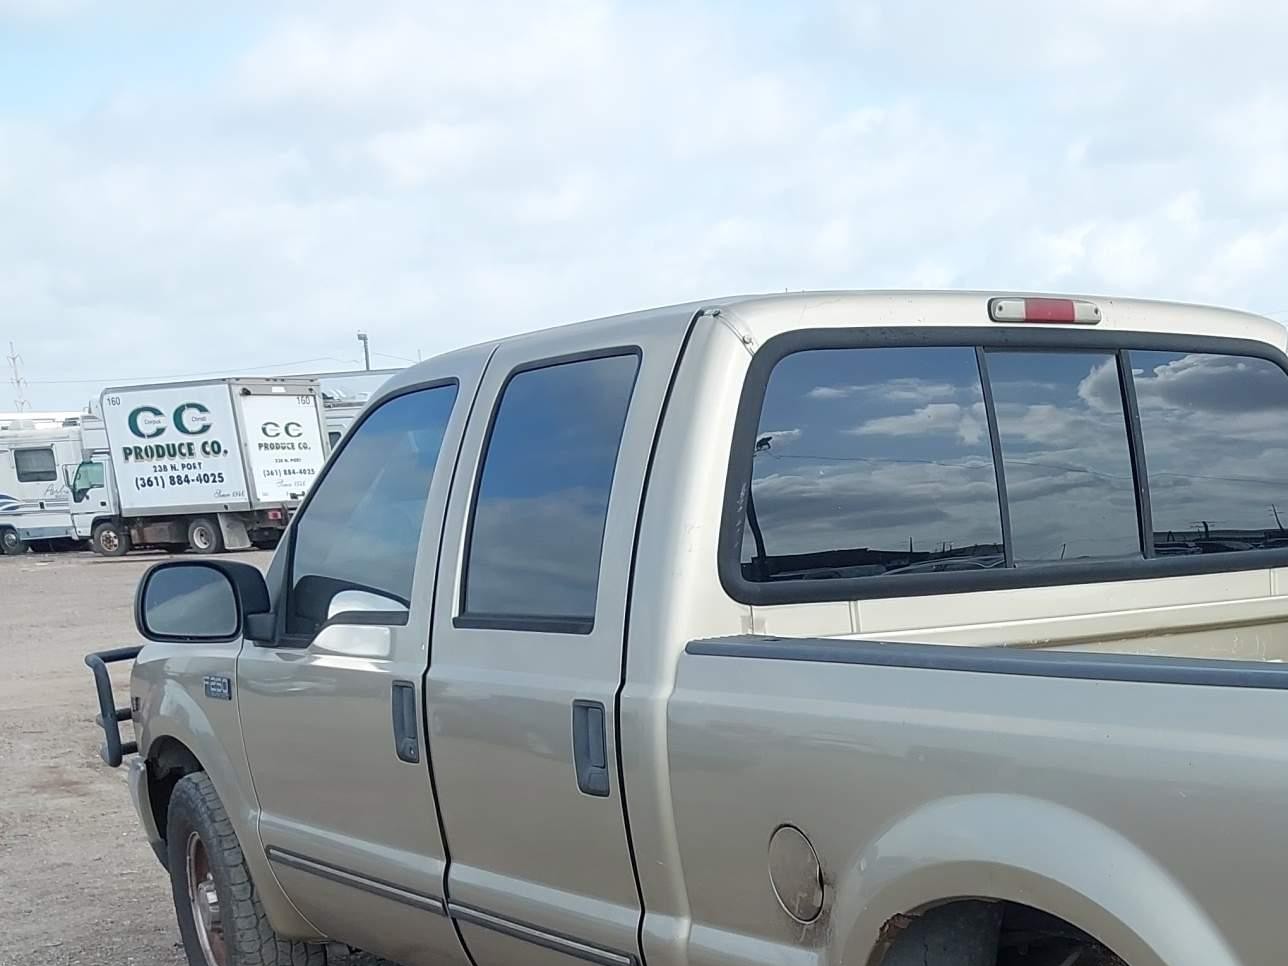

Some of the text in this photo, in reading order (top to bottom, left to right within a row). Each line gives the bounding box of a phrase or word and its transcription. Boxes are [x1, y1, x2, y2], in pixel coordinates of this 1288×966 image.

[106, 396, 121, 406] 160
[296, 396, 311, 405] 160
[122, 440, 228, 462] PRODUCE CO.
[258, 442, 311, 451] PRODUCE CO.
[170, 463, 180, 472] N.
[263, 468, 315, 478] (361) 884-4025
[135, 472, 225, 490] (361) 884-4025
